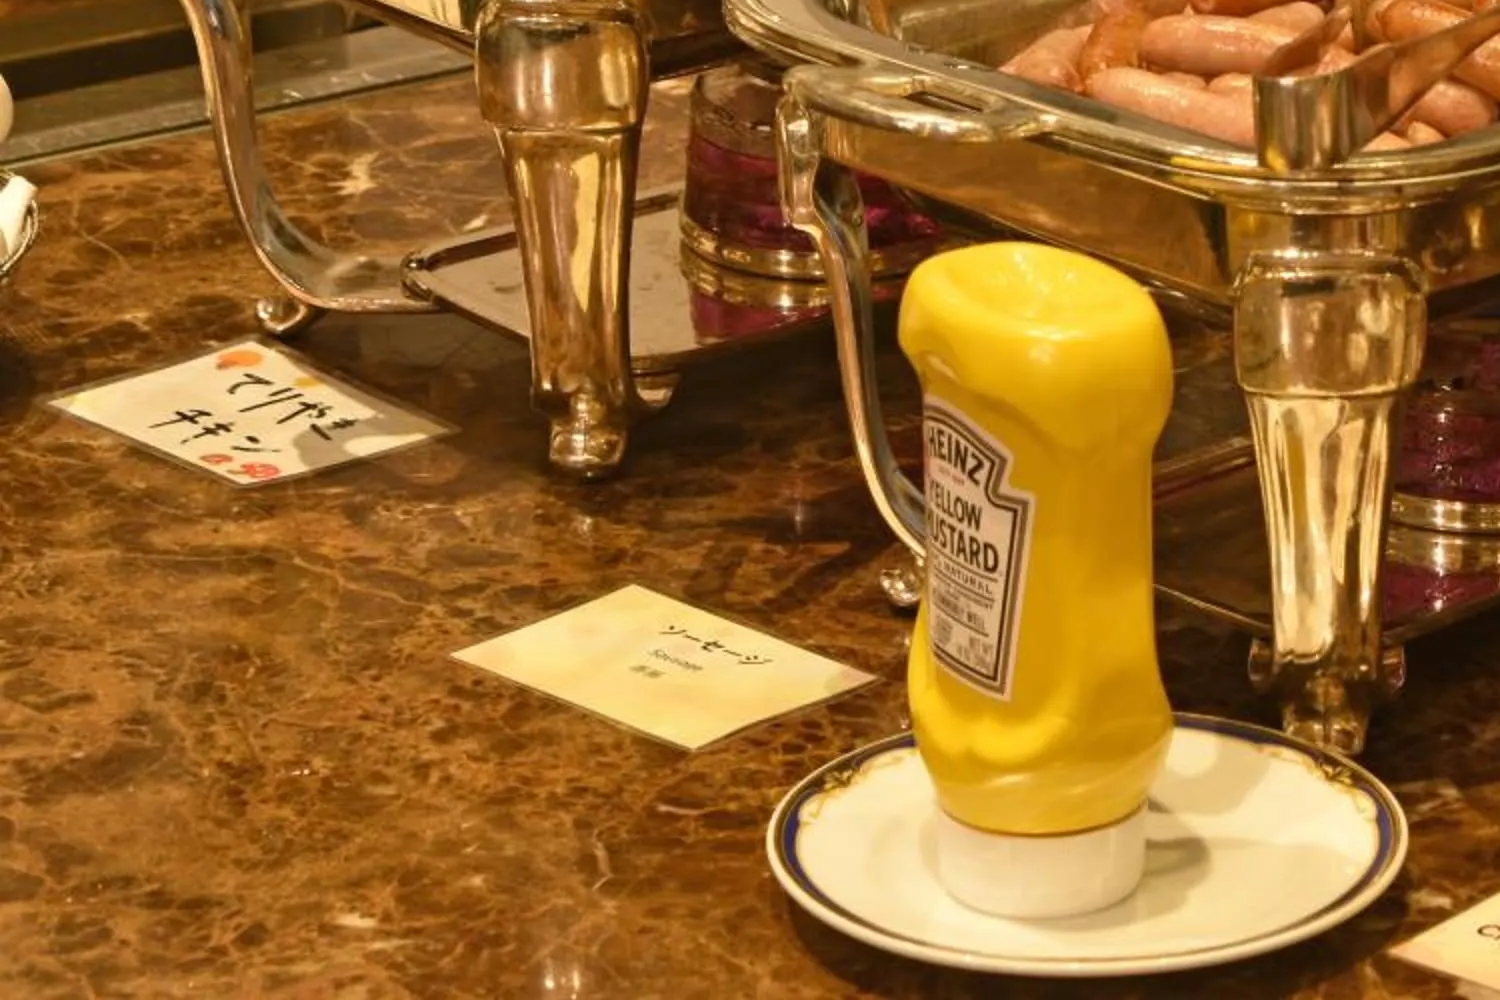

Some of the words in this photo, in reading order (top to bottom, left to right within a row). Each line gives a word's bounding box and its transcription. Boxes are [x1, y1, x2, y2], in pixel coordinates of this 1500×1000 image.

[148, 409, 283, 453] チキン
[227, 373, 358, 441] てりやき
[928, 427, 985, 487] HEINZ
[929, 479, 982, 532] YELLOW
[659, 625, 775, 665] ソーセージ
